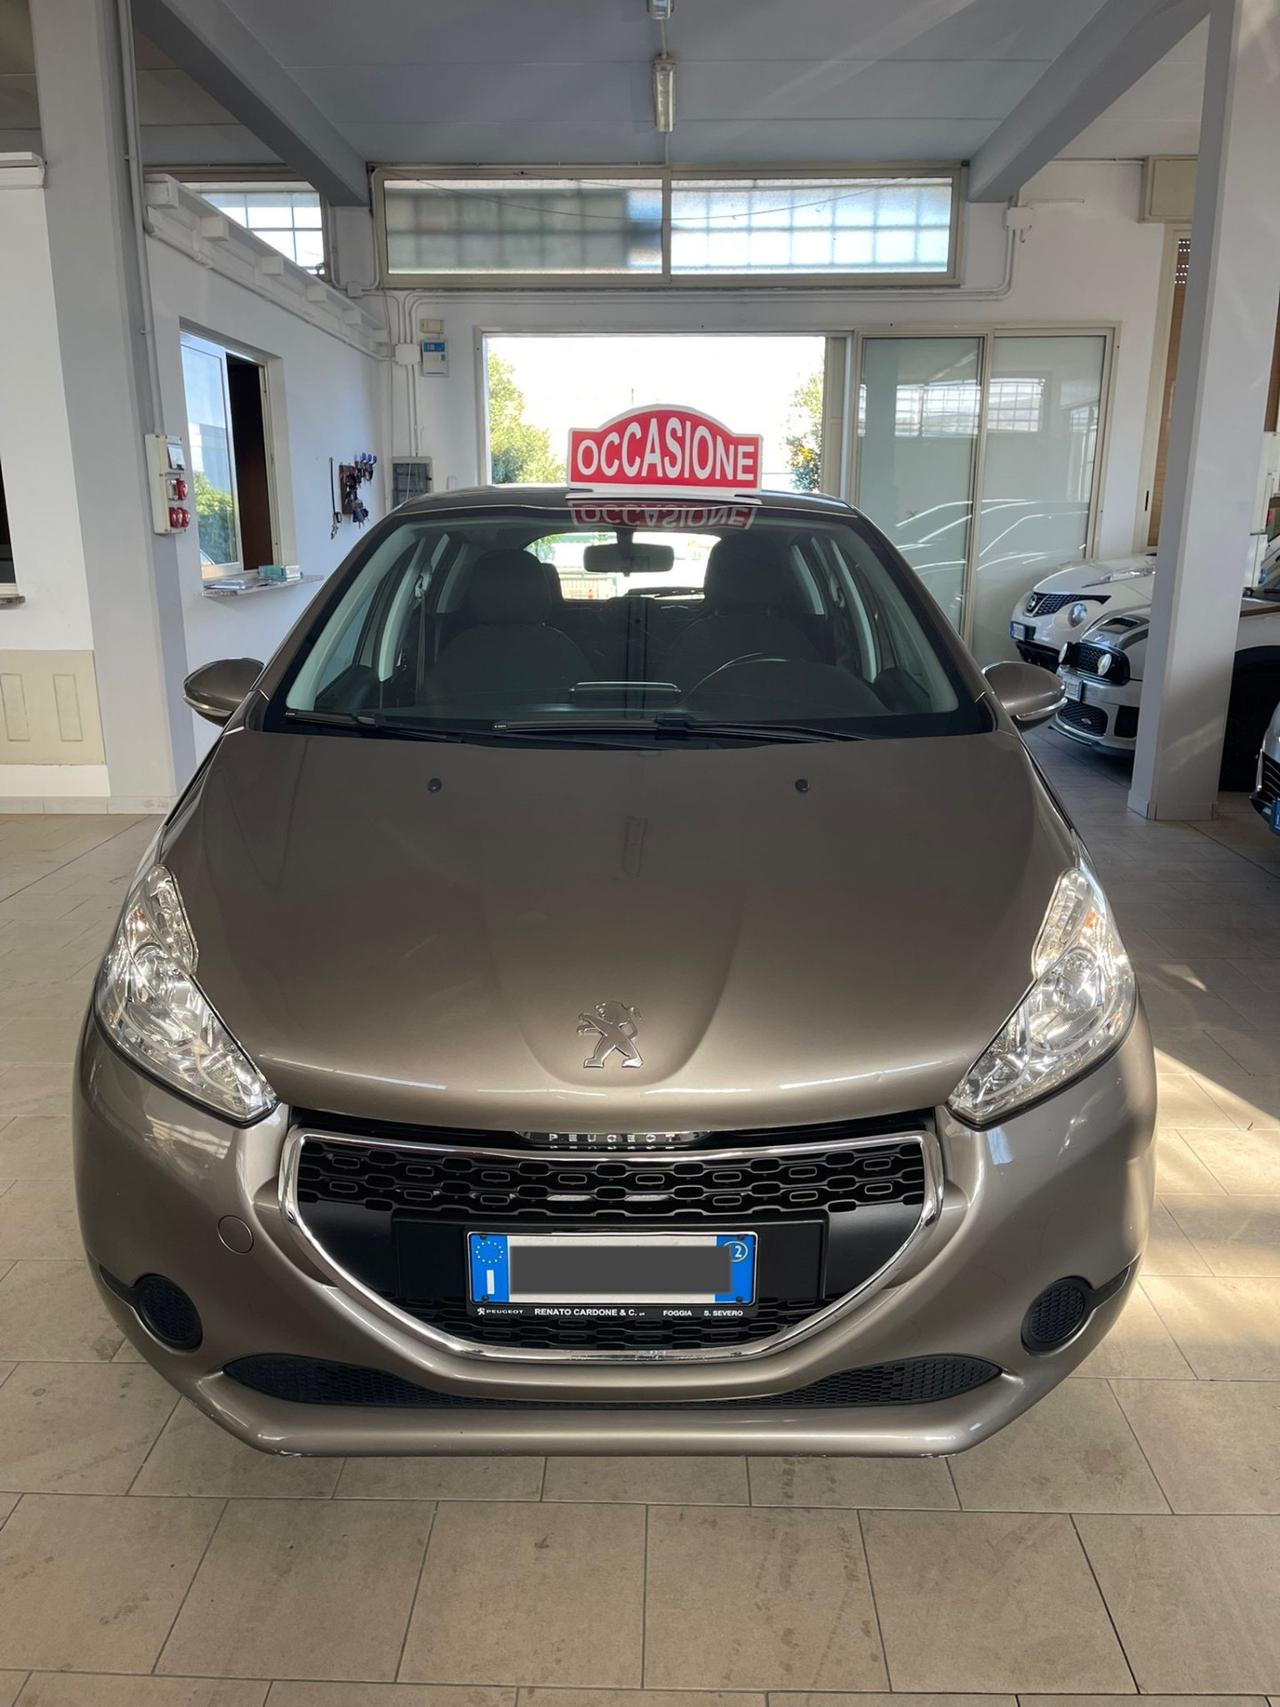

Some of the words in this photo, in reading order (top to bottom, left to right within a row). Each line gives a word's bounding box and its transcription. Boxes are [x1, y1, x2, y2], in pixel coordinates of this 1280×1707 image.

[576, 416, 755, 481] OCCASIONE
[548, 1133, 676, 1143] PEUGEOT
[734, 1245, 743, 1258] 2
[486, 1269, 495, 1295] I
[534, 1308, 571, 1316] RENATO
[573, 1308, 617, 1316] CARDONE
